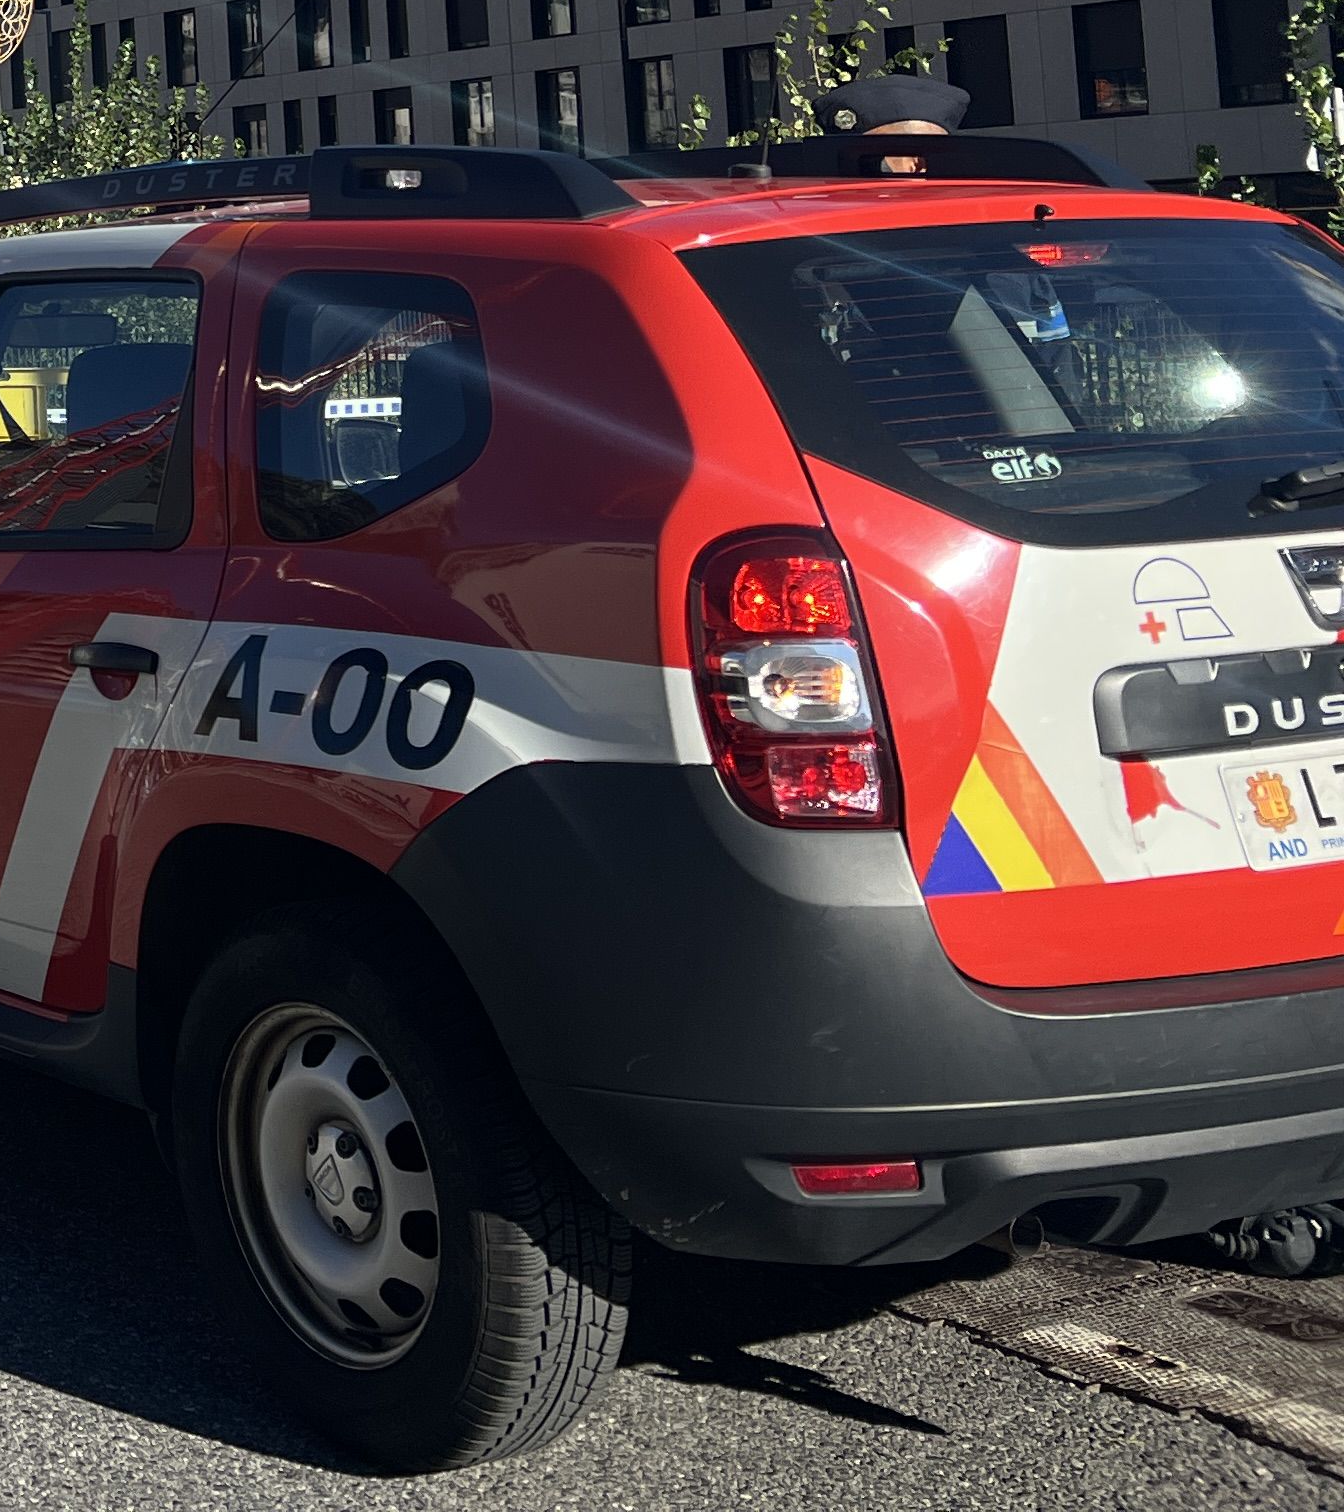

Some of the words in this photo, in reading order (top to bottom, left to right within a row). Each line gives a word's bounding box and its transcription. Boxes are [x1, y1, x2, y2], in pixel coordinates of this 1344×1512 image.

[102, 164, 297, 199] DUSTER
[982, 446, 1027, 460] DACIA
[991, 456, 1035, 481] elf
[194, 634, 476, 771] A-00
[1268, 838, 1308, 861] AND
